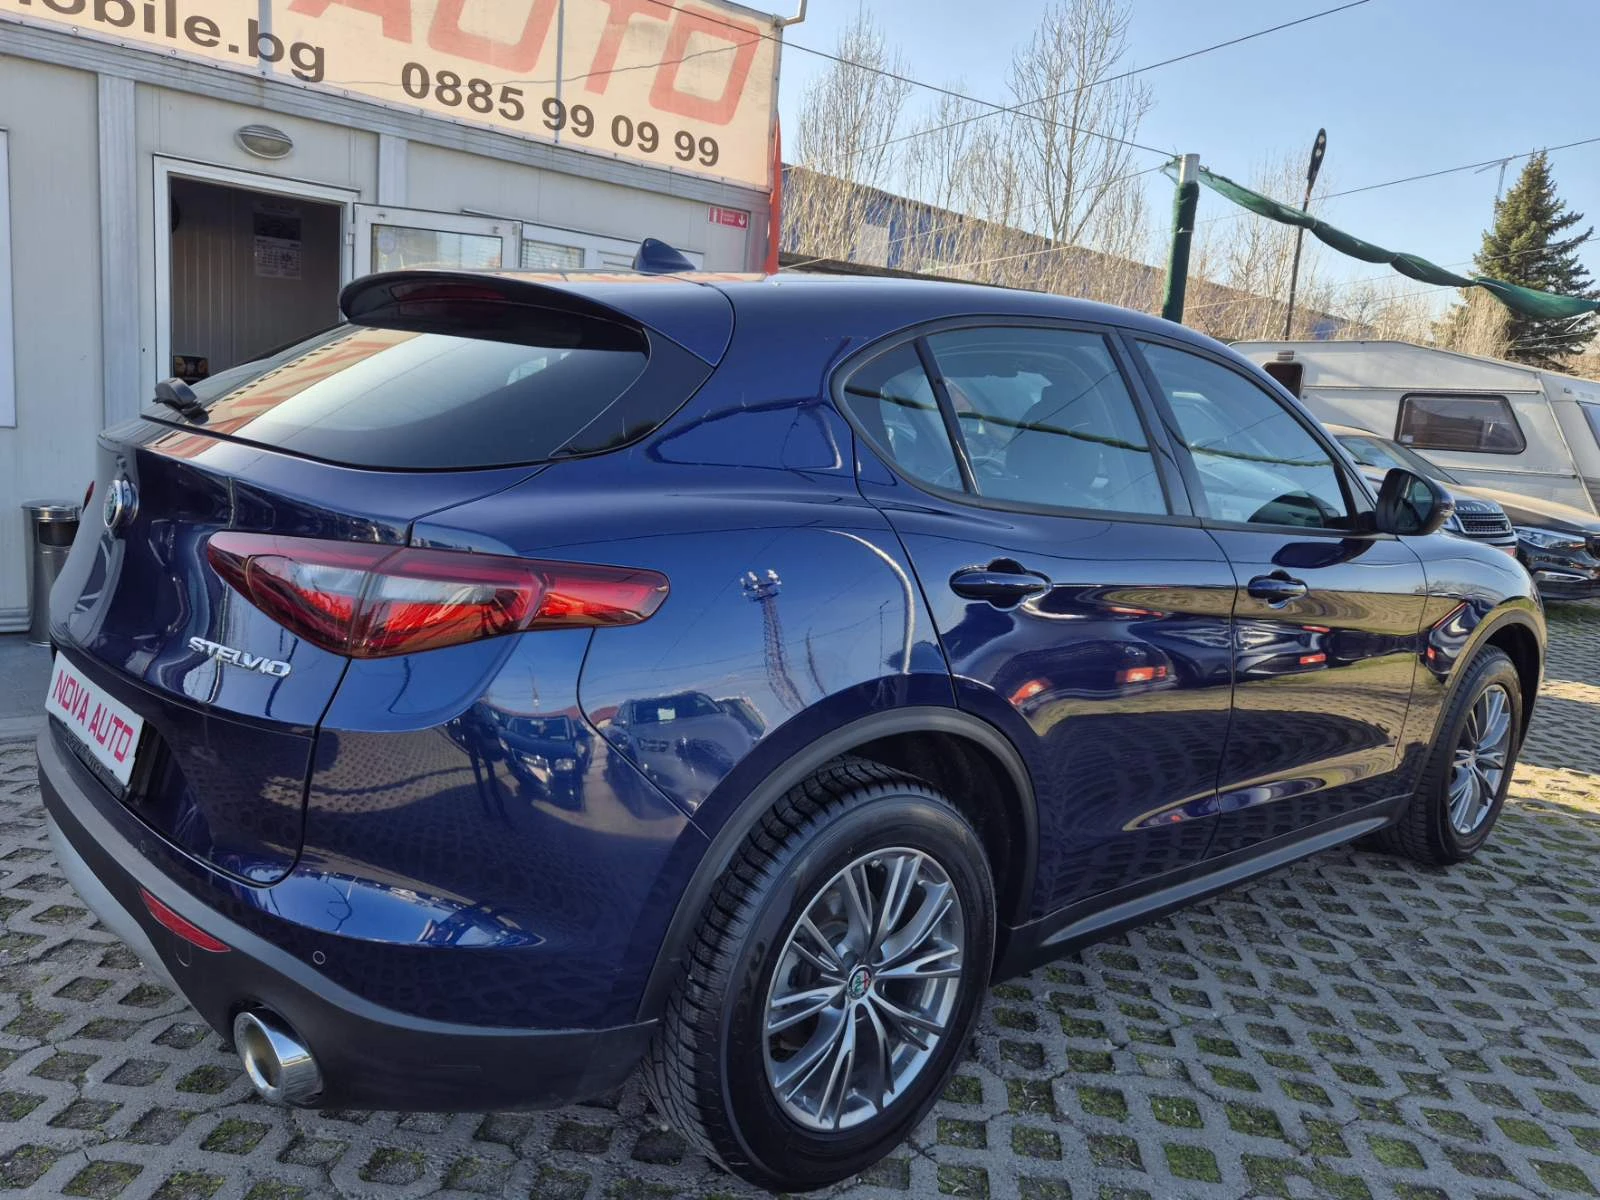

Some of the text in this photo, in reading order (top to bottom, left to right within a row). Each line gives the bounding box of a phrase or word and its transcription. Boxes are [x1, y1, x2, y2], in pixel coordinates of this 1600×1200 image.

[18, 0, 325, 83] bile.bg
[401, 62, 720, 167] 0885 99 09 99
[188, 636, 292, 678] STELVIO
[52, 669, 91, 726] NOVA
[88, 703, 134, 763] AUTO
